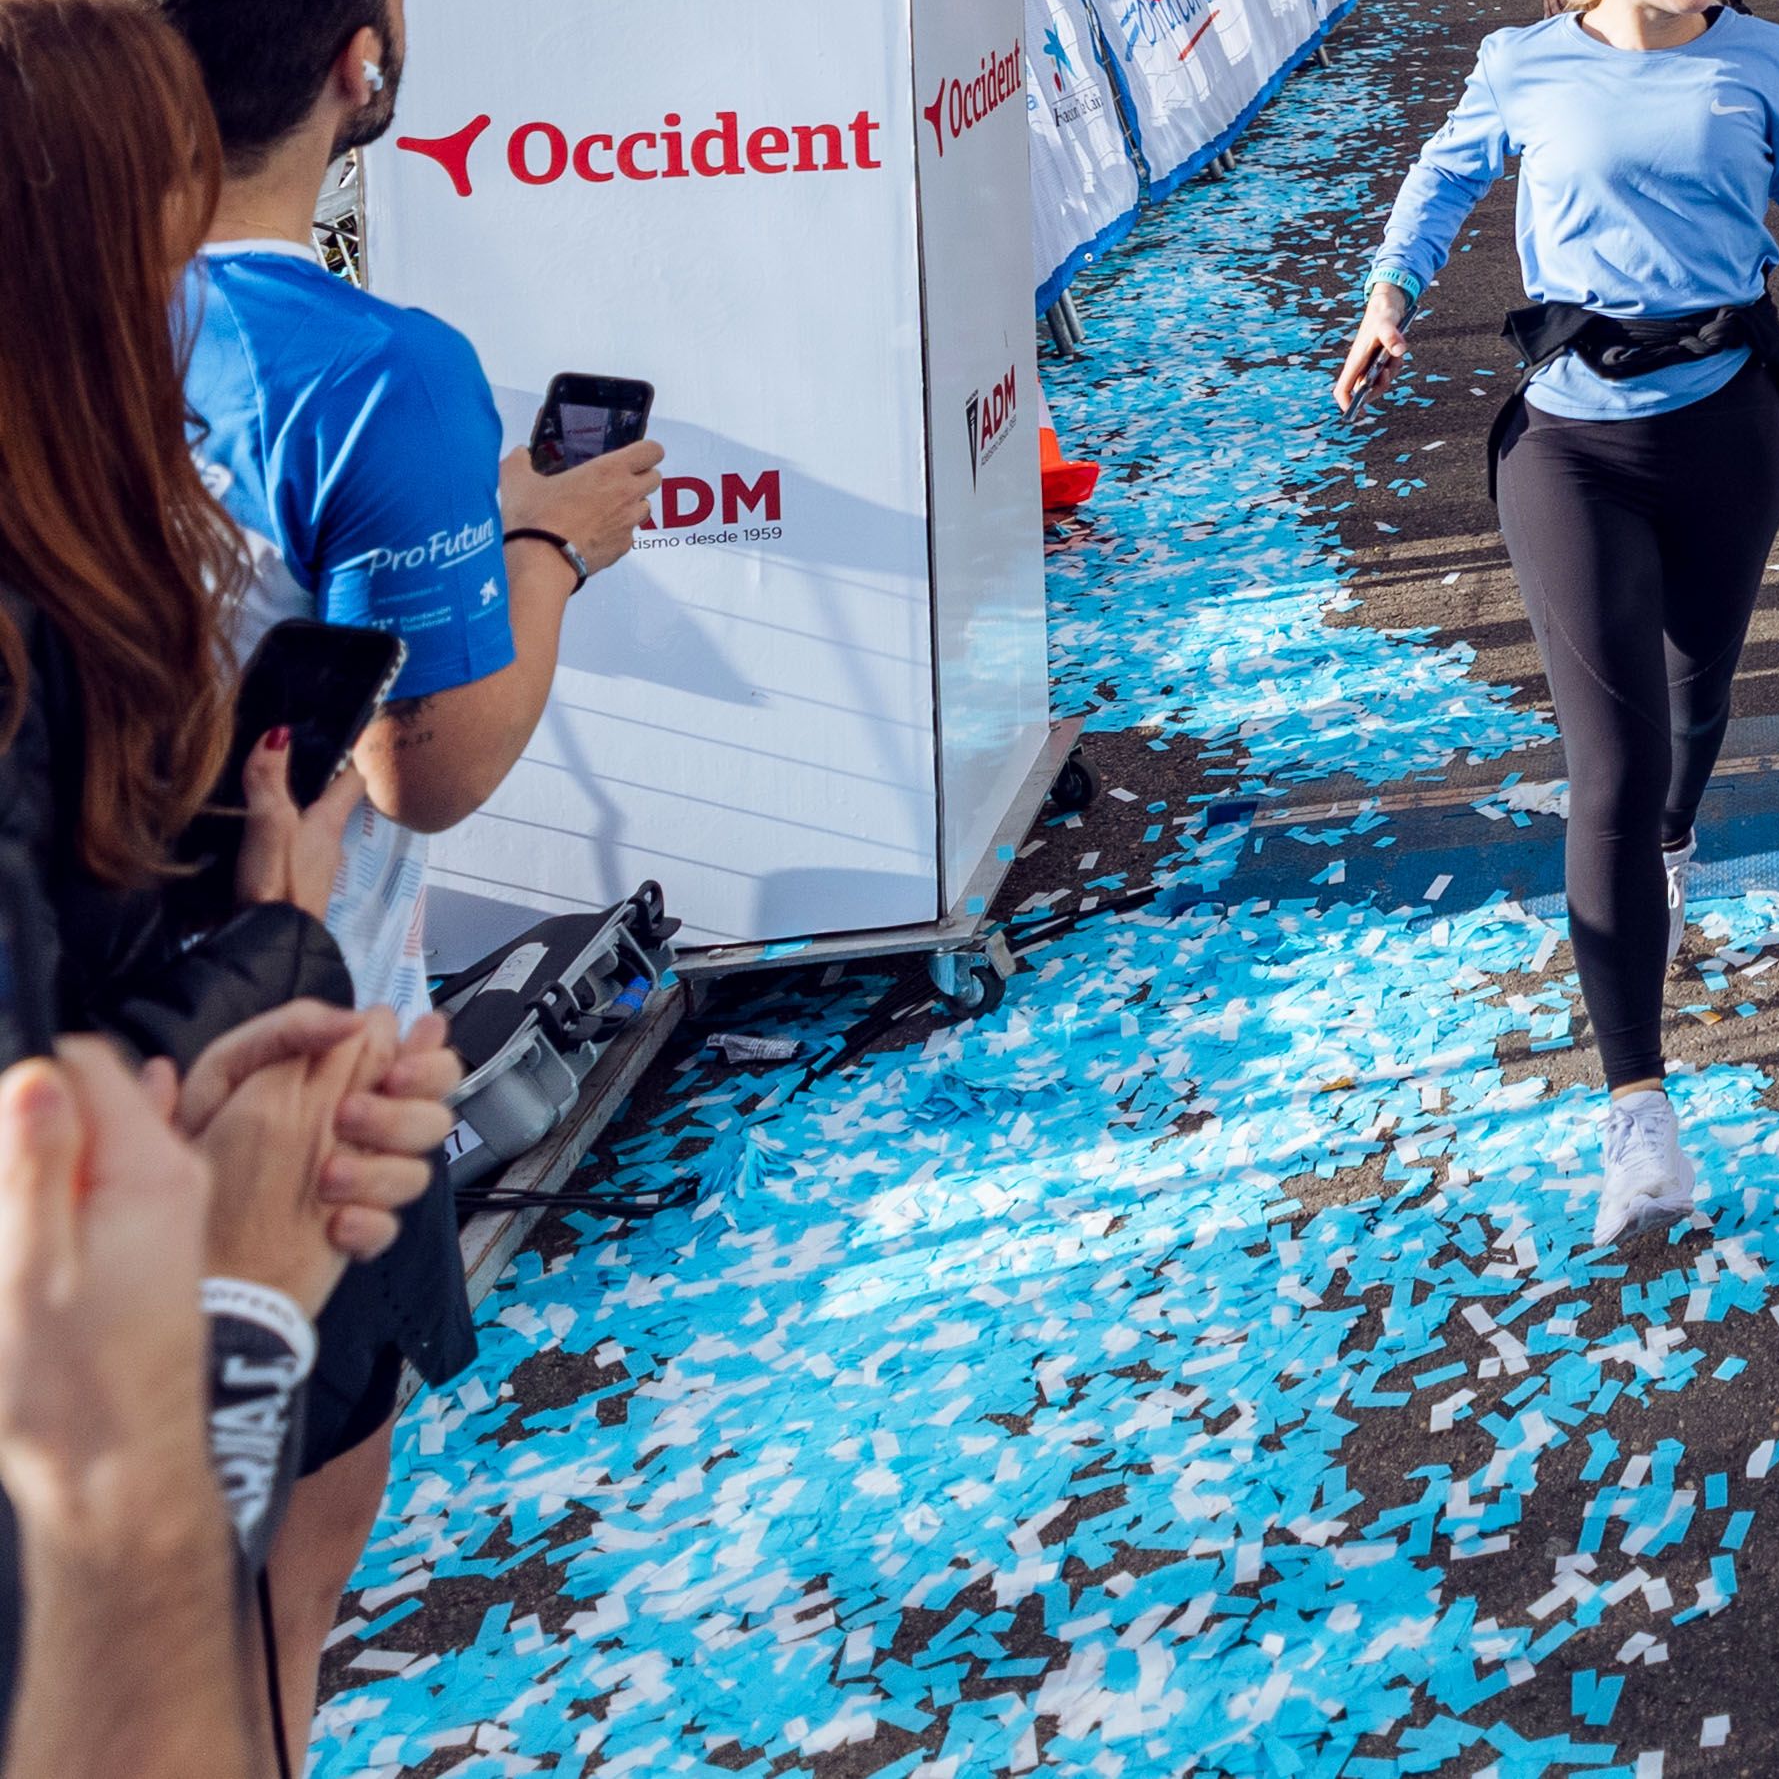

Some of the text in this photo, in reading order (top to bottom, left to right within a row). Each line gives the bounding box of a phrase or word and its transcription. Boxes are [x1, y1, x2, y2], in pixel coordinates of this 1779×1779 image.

[949, 37, 1022, 140] Occident
[507, 111, 881, 186] Occident
[980, 364, 1016, 452] ADM
[685, 530, 738, 547] desde
[743, 526, 783, 542] 1959
